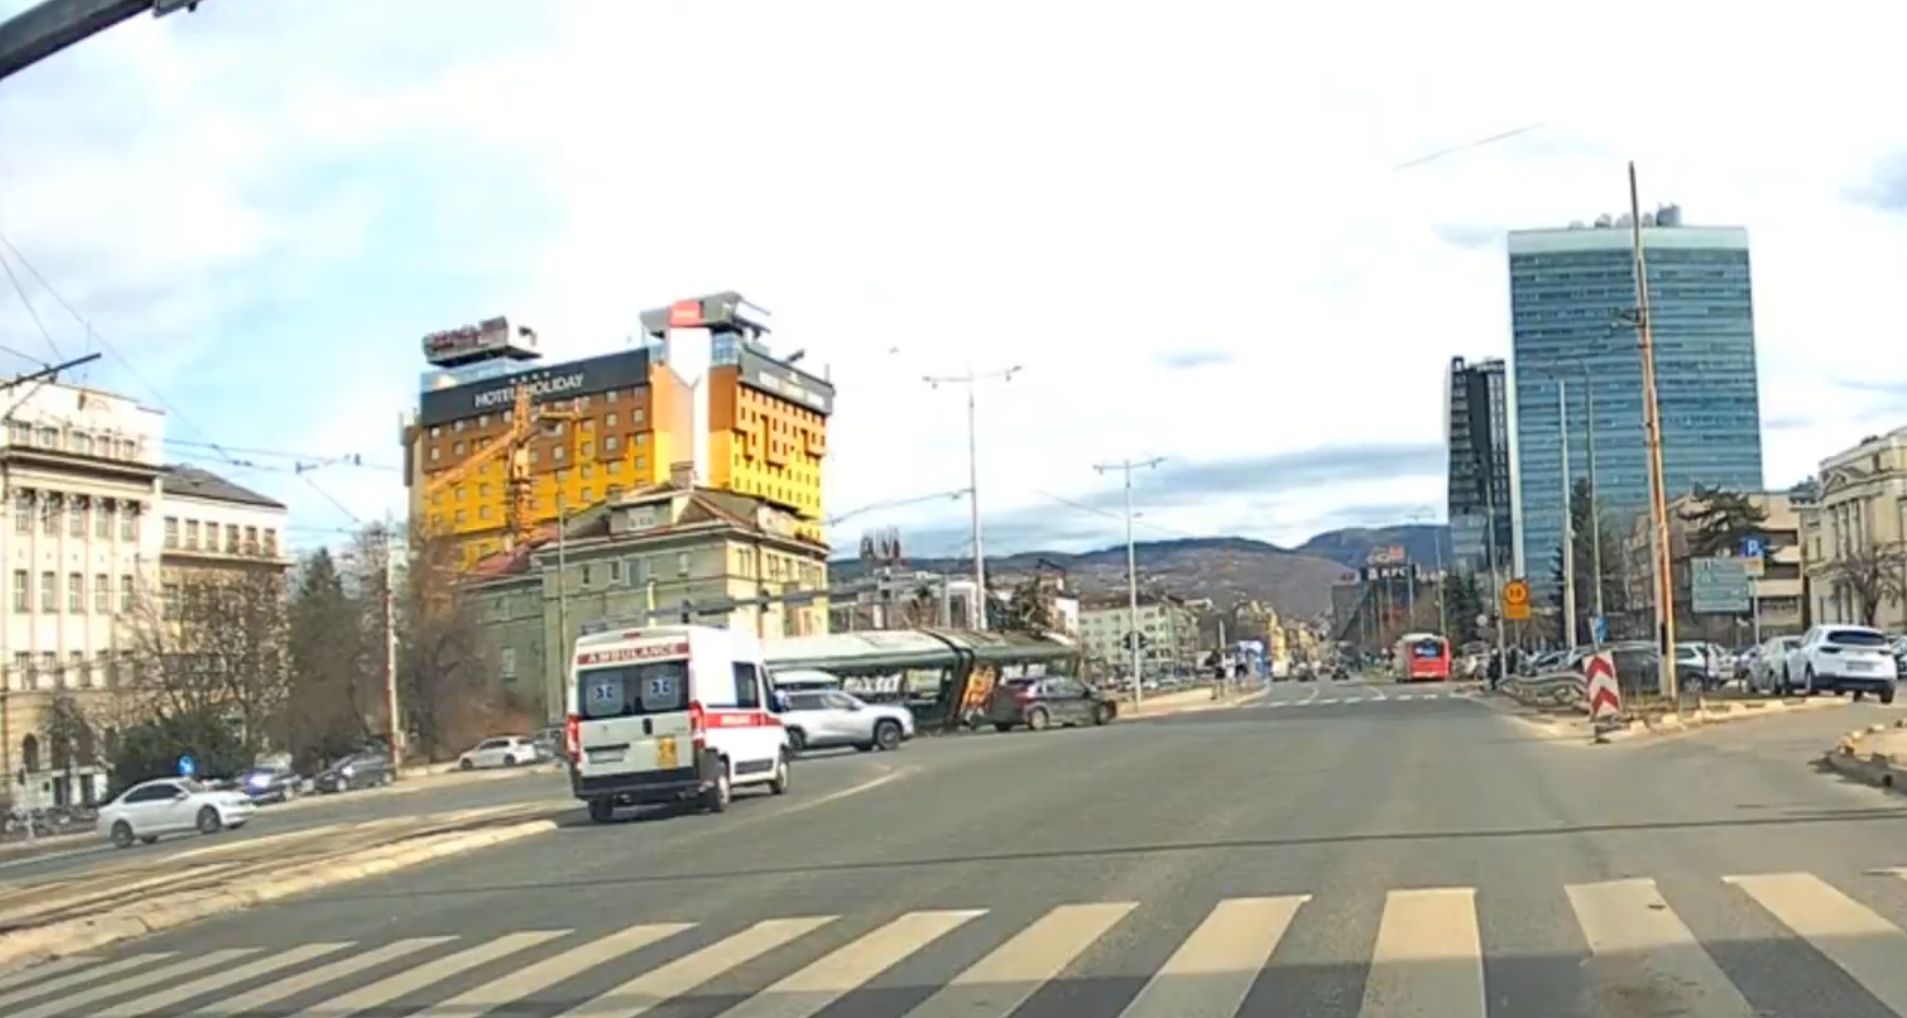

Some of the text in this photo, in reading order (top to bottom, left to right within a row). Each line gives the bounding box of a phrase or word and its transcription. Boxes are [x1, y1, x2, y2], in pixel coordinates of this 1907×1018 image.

[474, 372, 584, 409] HOTEL HOLIDAY
[588, 644, 676, 664] AMBULANCE
